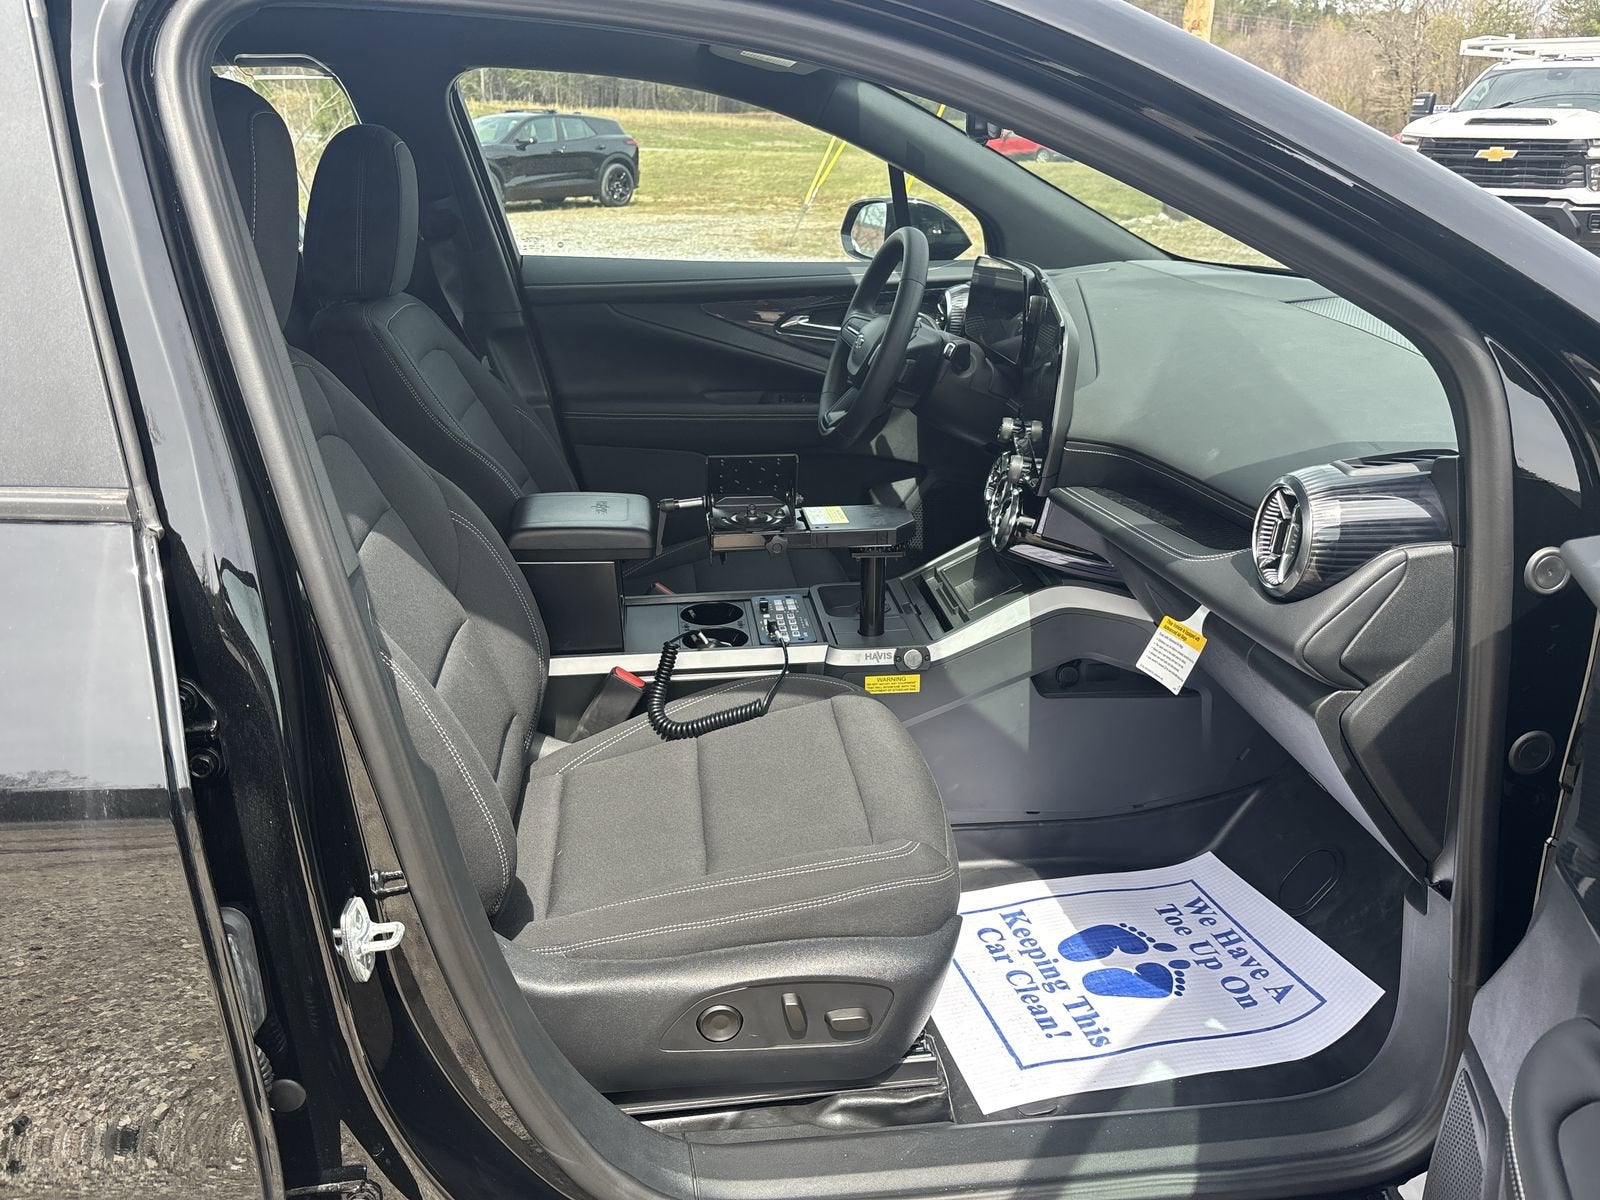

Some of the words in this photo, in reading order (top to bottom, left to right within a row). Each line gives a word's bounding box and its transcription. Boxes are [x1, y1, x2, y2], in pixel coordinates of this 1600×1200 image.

[865, 651, 892, 662] HAVIS
[976, 927, 1014, 964] Car
[1005, 969, 1073, 1039] Clean!
[999, 908, 1071, 994] Keeping
[1062, 995, 1112, 1048] This
[1154, 903, 1193, 936] Toe
[1188, 939, 1223, 970] Up
[1220, 975, 1258, 1010] On
[1183, 896, 1218, 926] We
[1210, 927, 1270, 980] Have
[1262, 984, 1295, 1005] A
